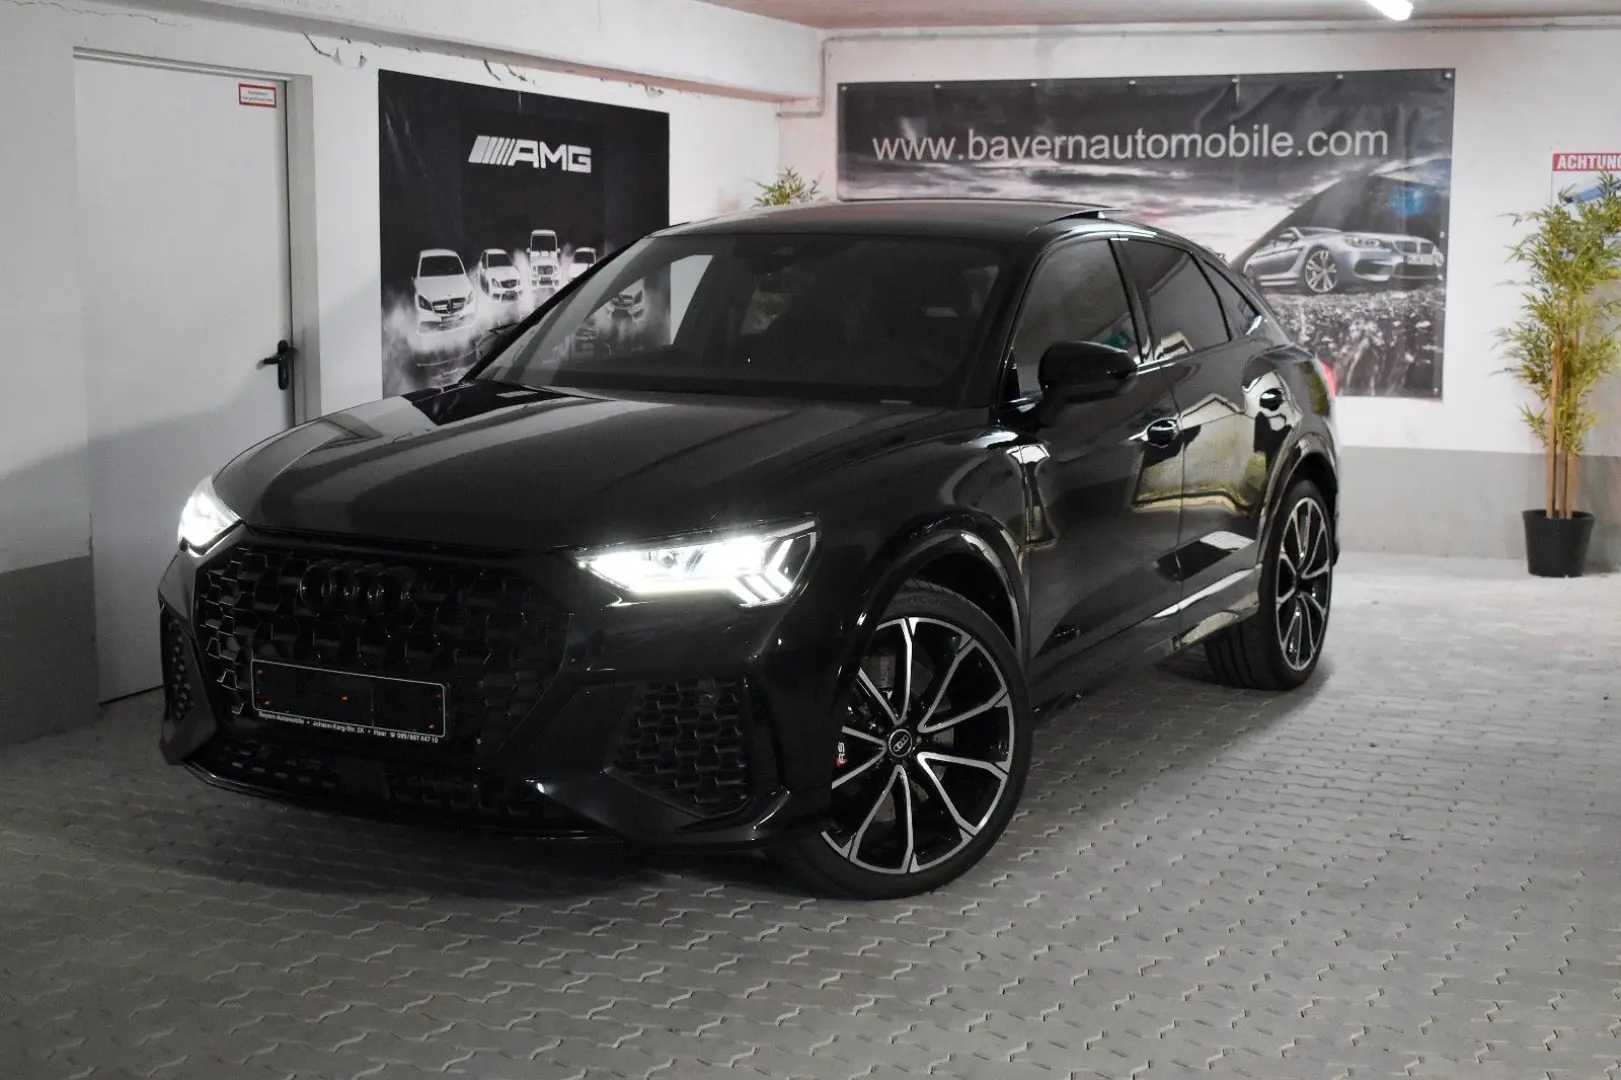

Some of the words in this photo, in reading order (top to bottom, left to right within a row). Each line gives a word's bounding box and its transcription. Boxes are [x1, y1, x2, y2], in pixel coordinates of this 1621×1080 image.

[507, 138, 592, 174] AMG
[872, 124, 1388, 166] www.bayernautomobile.com
[837, 741, 848, 763] RS
